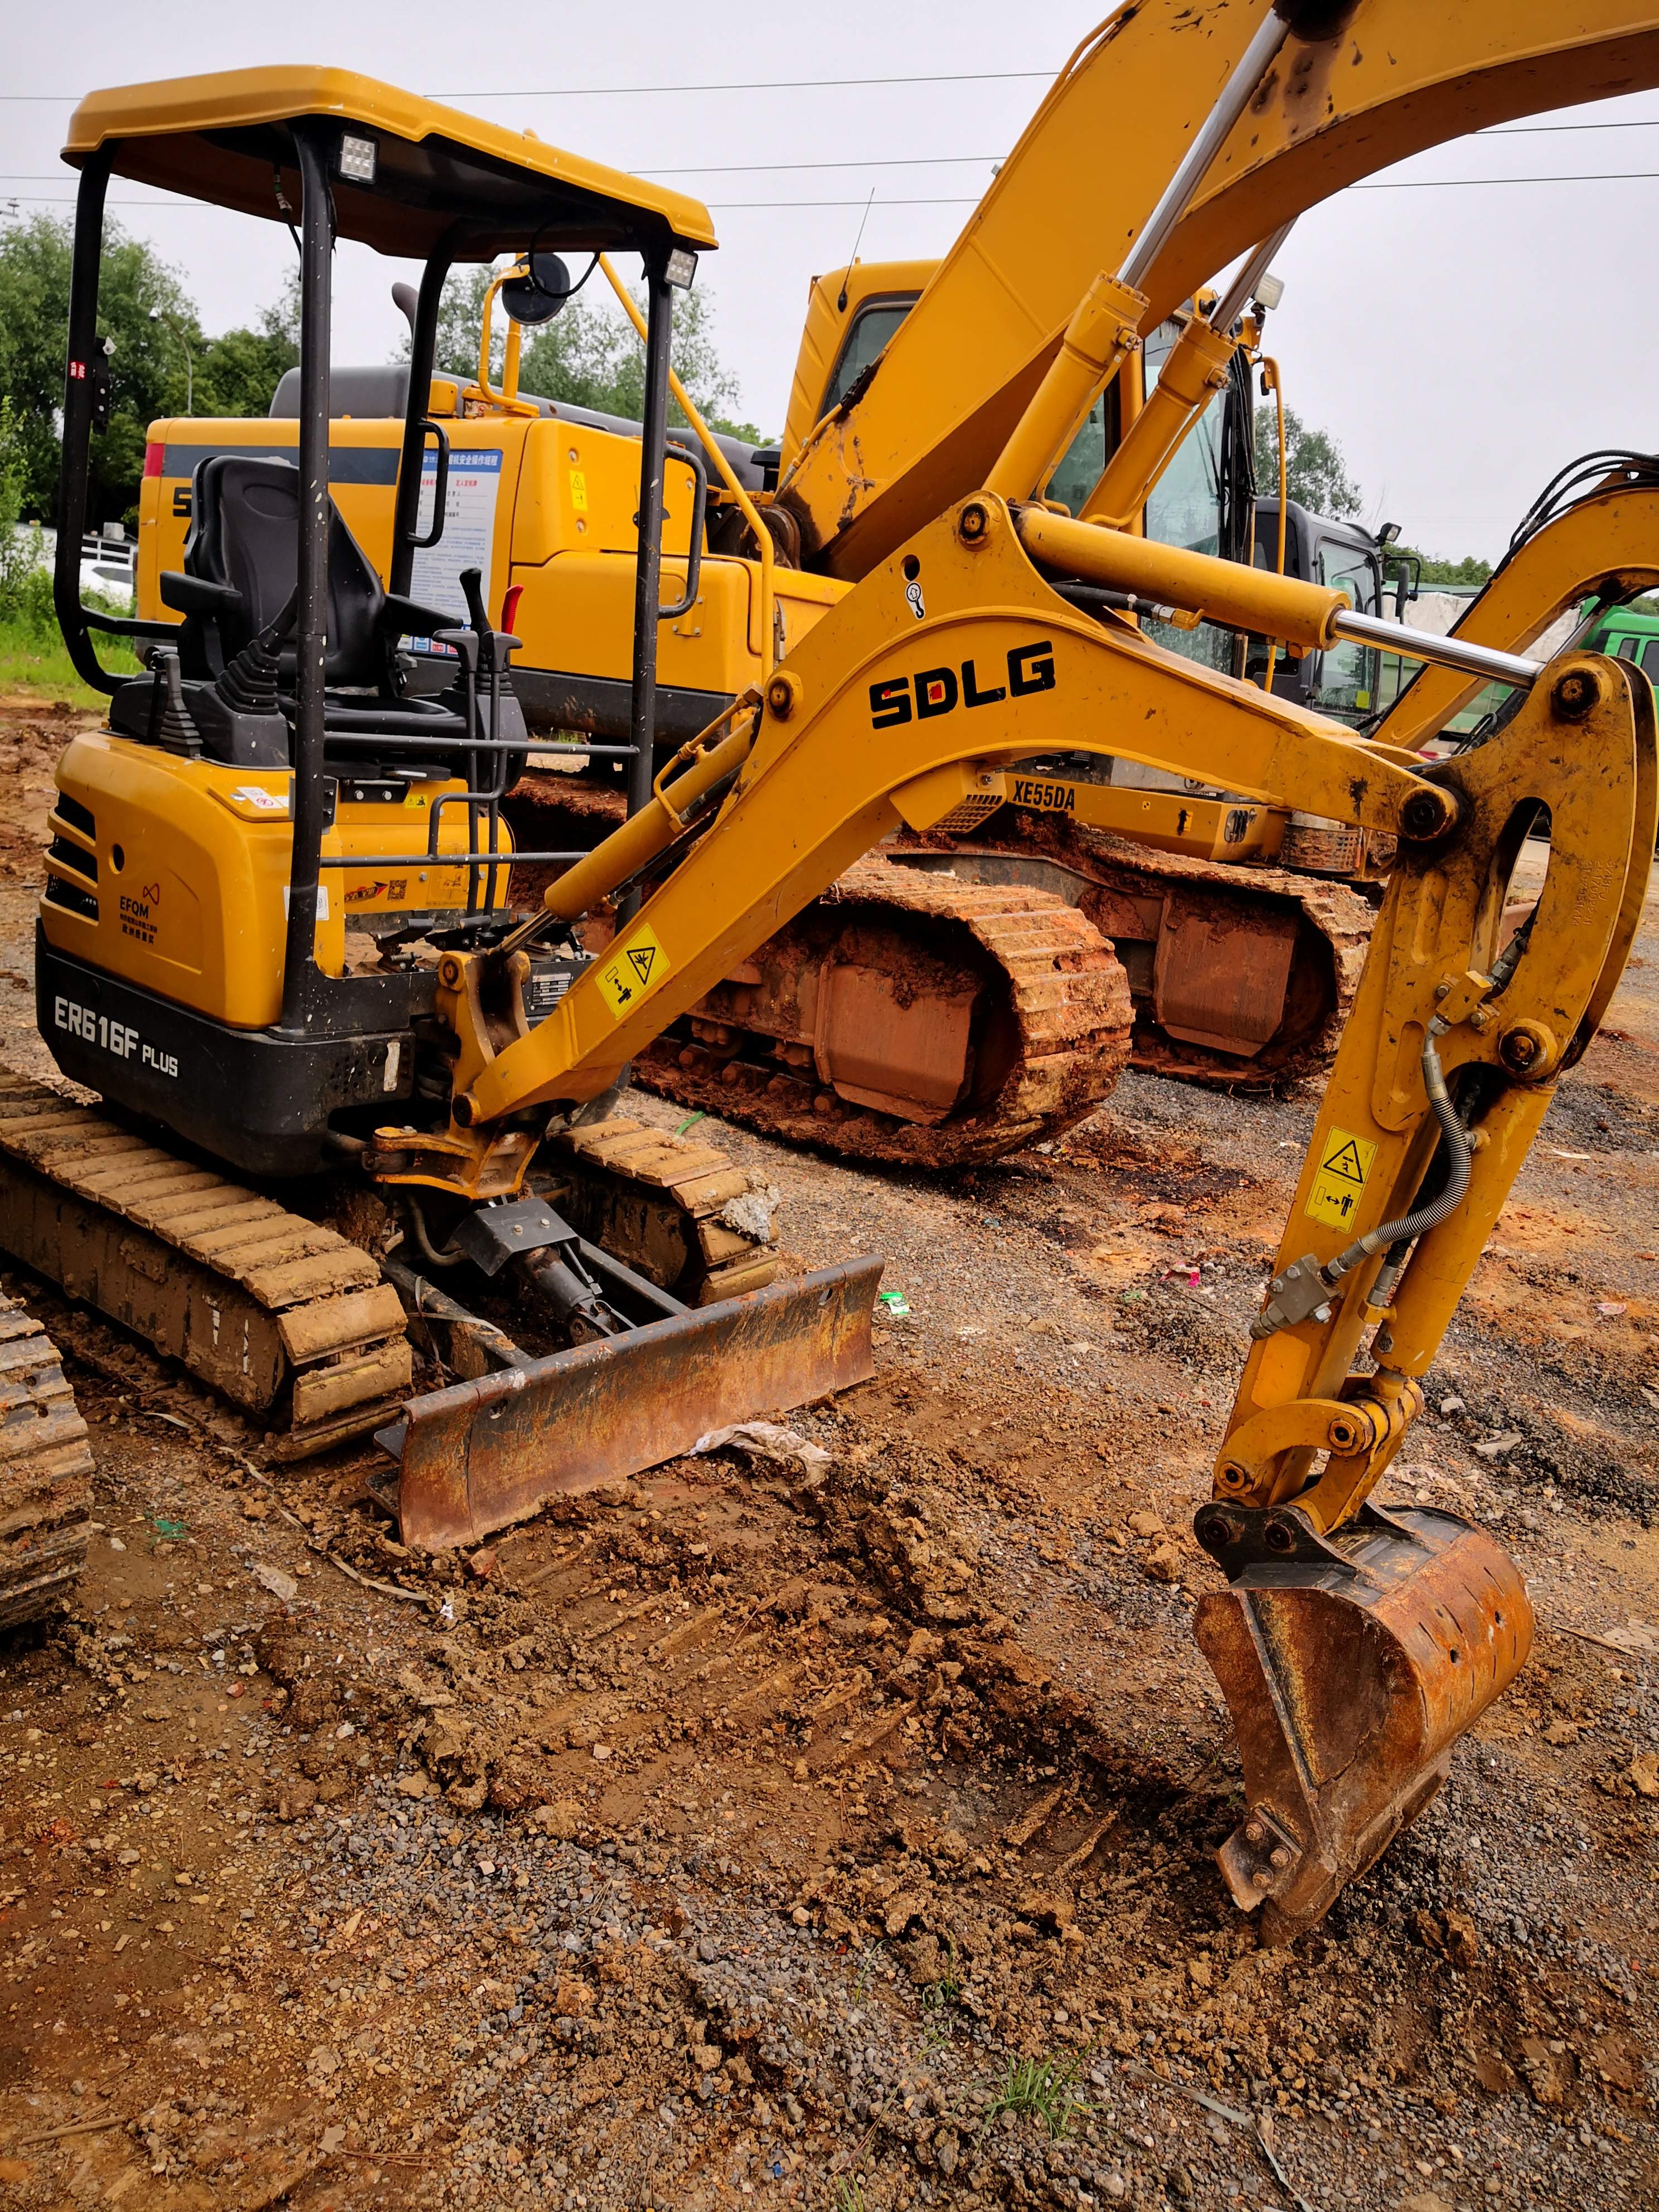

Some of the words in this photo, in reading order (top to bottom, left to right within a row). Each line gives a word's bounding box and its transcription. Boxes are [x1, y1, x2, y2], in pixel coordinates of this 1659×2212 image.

[869, 641, 1056, 730] SDLG
[1012, 780, 1075, 811] XE55DA
[120, 896, 149, 919] EFQM
[55, 996, 139, 1059] ER616F
[142, 1044, 178, 1078] PLUS
